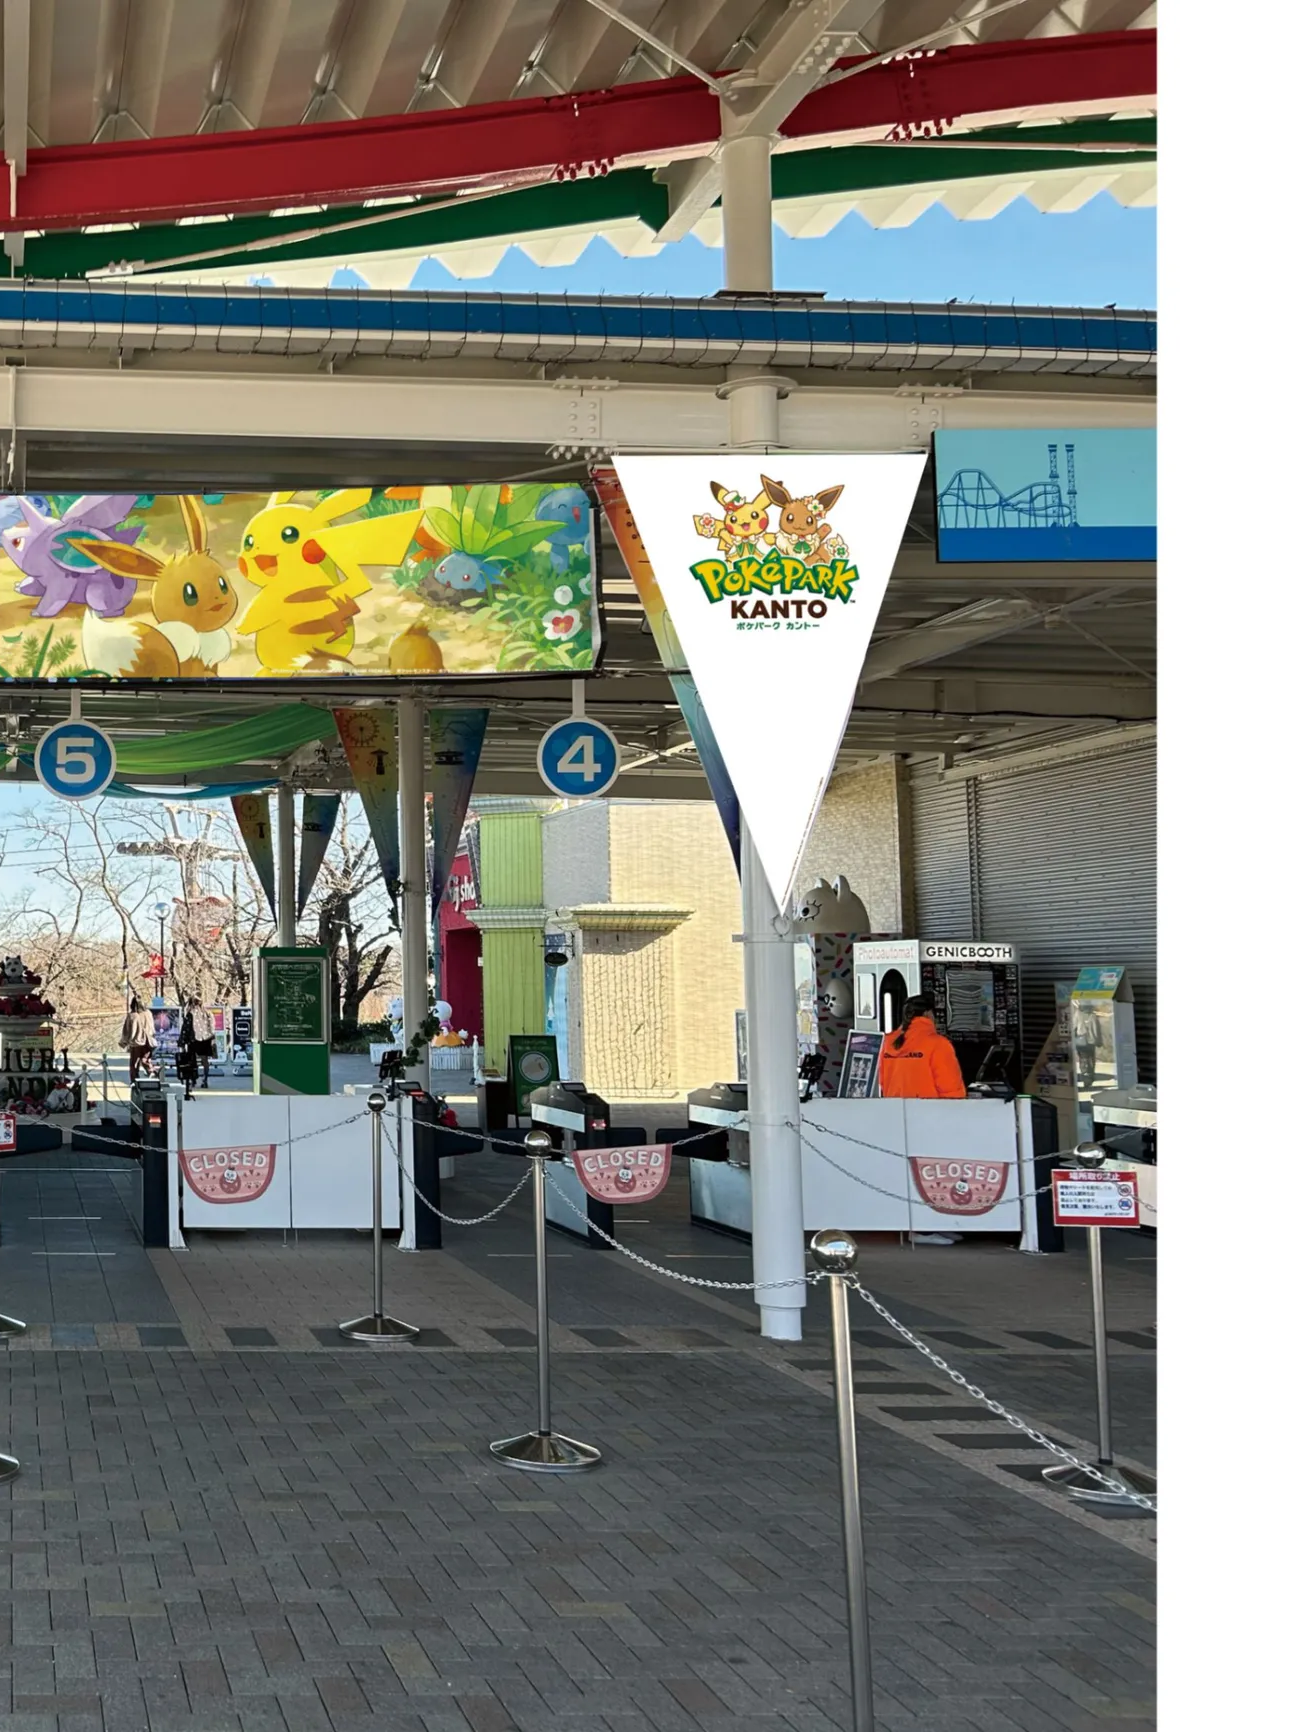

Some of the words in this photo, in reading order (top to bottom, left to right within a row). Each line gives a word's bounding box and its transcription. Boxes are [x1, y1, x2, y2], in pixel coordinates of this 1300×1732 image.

[731, 600, 828, 619] KANTO
[736, 622, 780, 630] ポケパーク
[786, 622, 820, 630] カントー
[55, 737, 96, 783] 5
[557, 736, 601, 781] 4
[926, 946, 1013, 958] GENICBOOTH
[190, 1151, 267, 1172] CLOSED
[584, 1151, 663, 1173] CLOSED
[922, 1163, 1000, 1183] CLOSED
